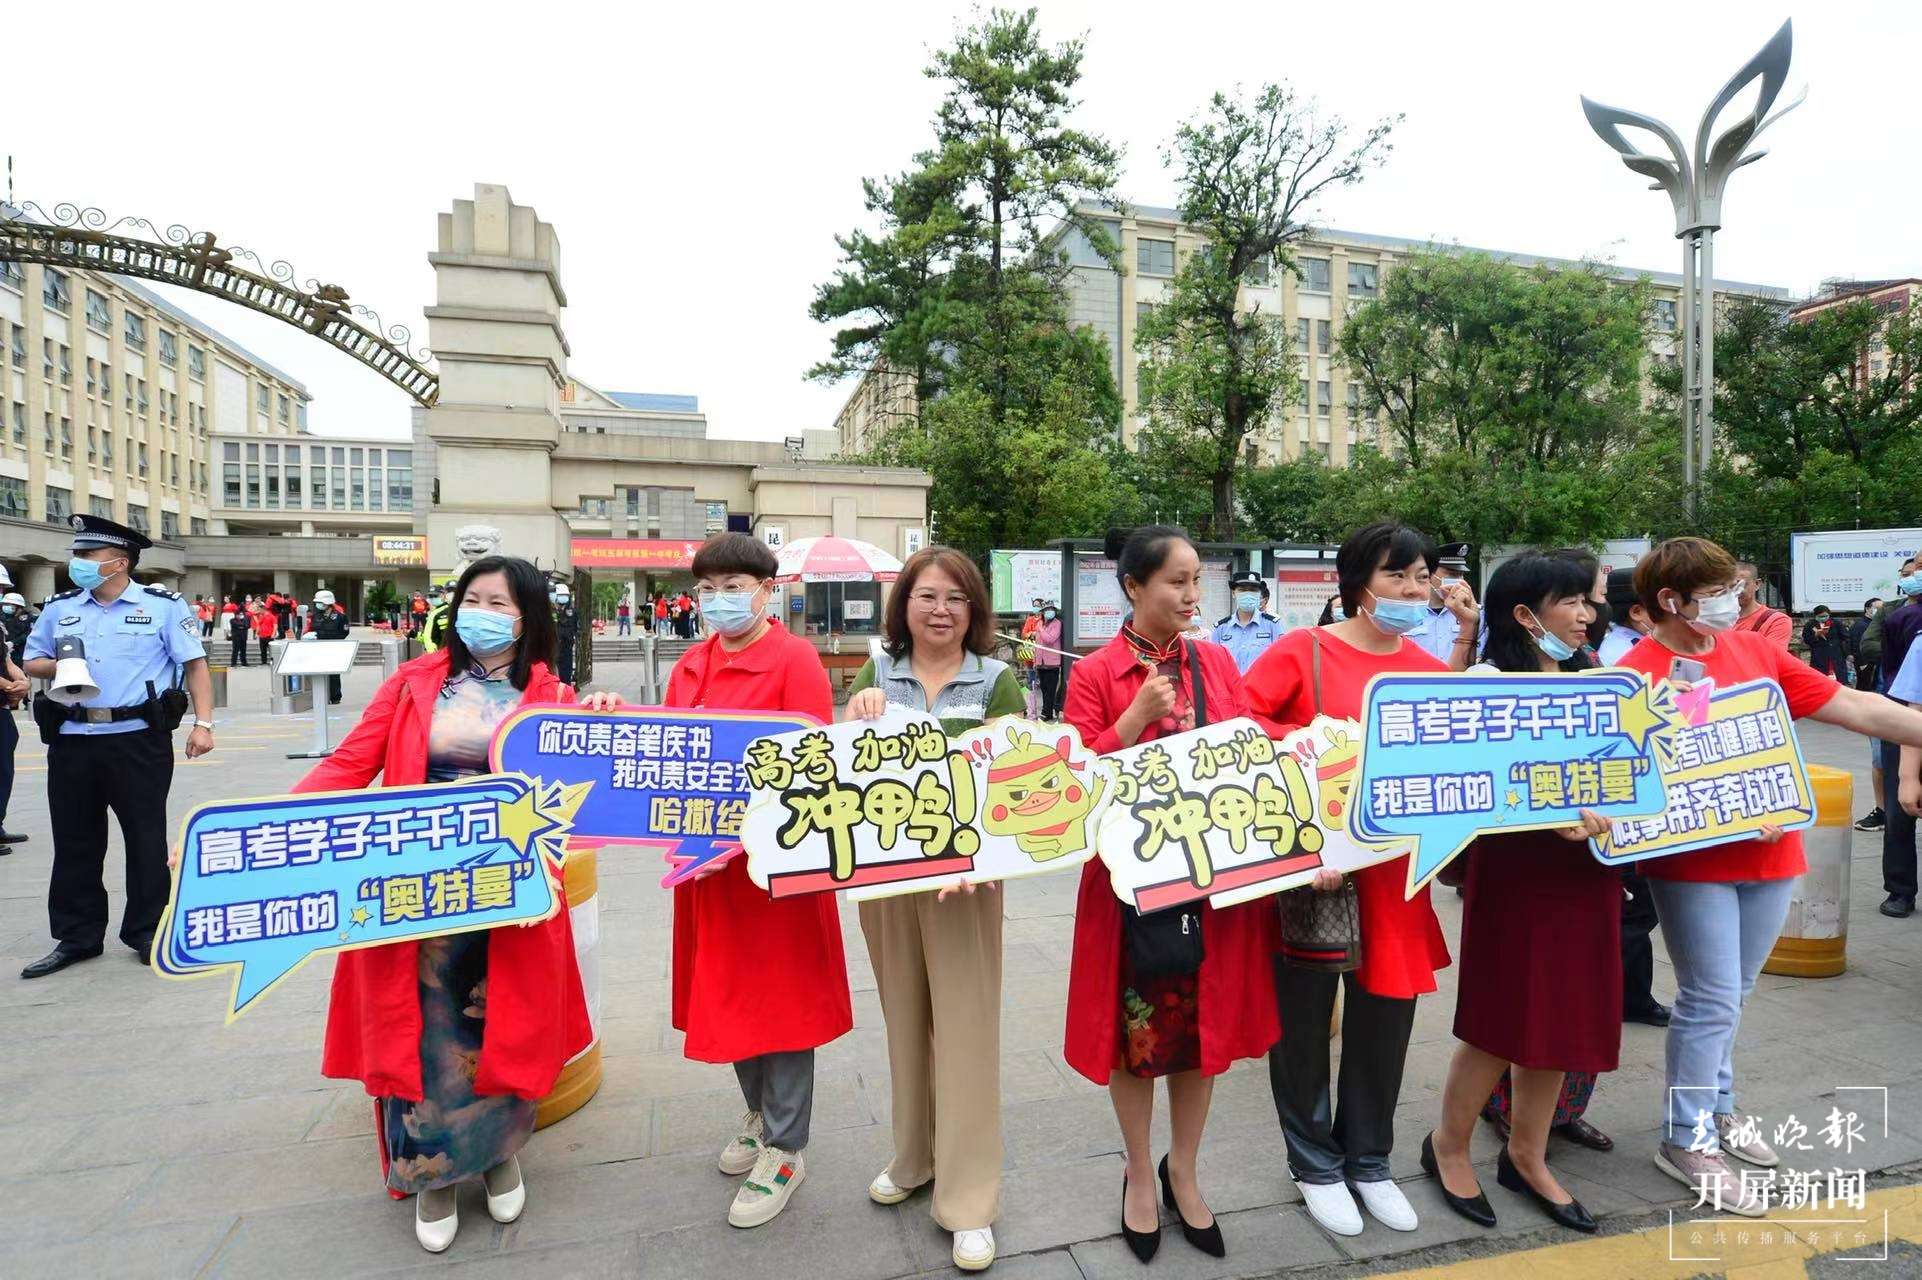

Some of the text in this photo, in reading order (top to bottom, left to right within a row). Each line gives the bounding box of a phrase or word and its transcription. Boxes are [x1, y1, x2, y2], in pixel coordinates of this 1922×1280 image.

[538, 720, 712, 759] 你负责奋笔疾书
[1378, 692, 1620, 746] 高考学子千千万
[1662, 709, 1786, 774] 考证健康码
[745, 721, 948, 790] 高考 加油
[1189, 727, 1276, 781] 加油
[1371, 771, 1495, 818] 我是你的
[198, 800, 498, 876] 高考学子千千万
[186, 892, 336, 947] 我是你的
